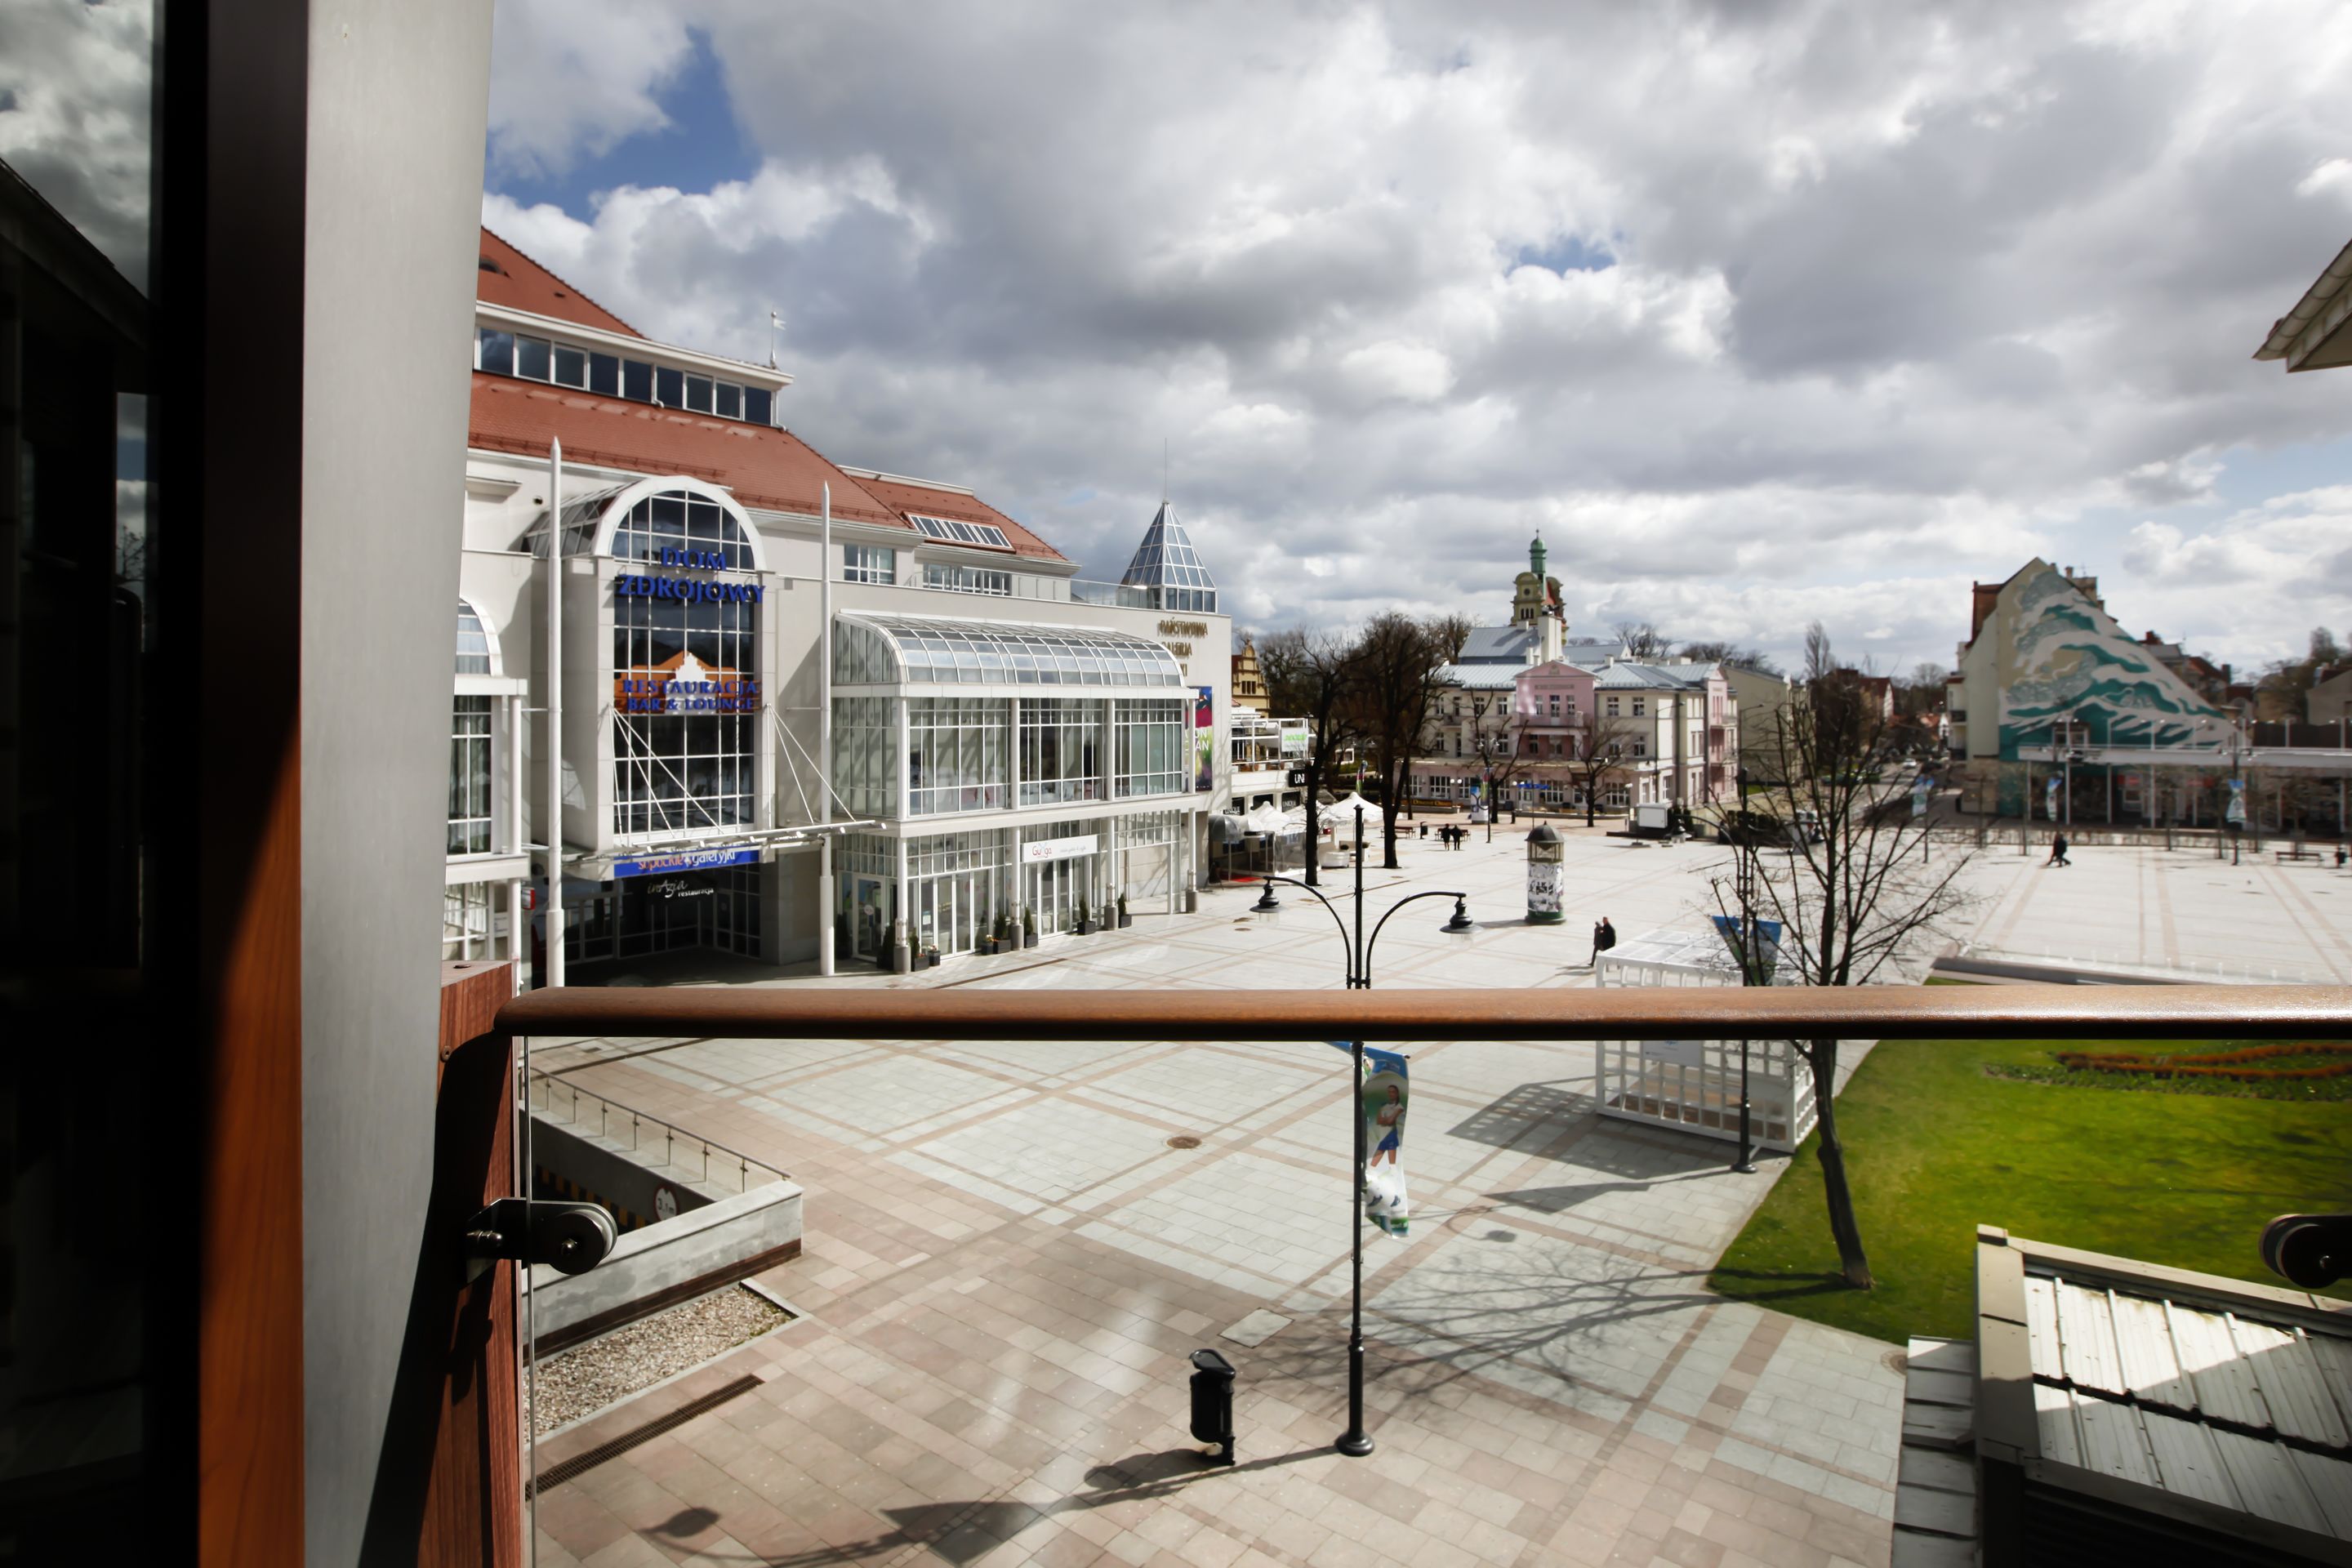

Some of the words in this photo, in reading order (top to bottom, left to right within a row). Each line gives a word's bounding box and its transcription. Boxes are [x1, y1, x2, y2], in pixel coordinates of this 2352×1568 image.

[661, 546, 727, 571] DOM
[618, 574, 766, 604] ZDROJOWY
[622, 679, 758, 695] RESTAURACJA
[626, 697, 662, 711] BAR
[666, 697, 679, 711] &
[684, 697, 755, 711] LOUNGE
[678, 887, 715, 898] restauracja
